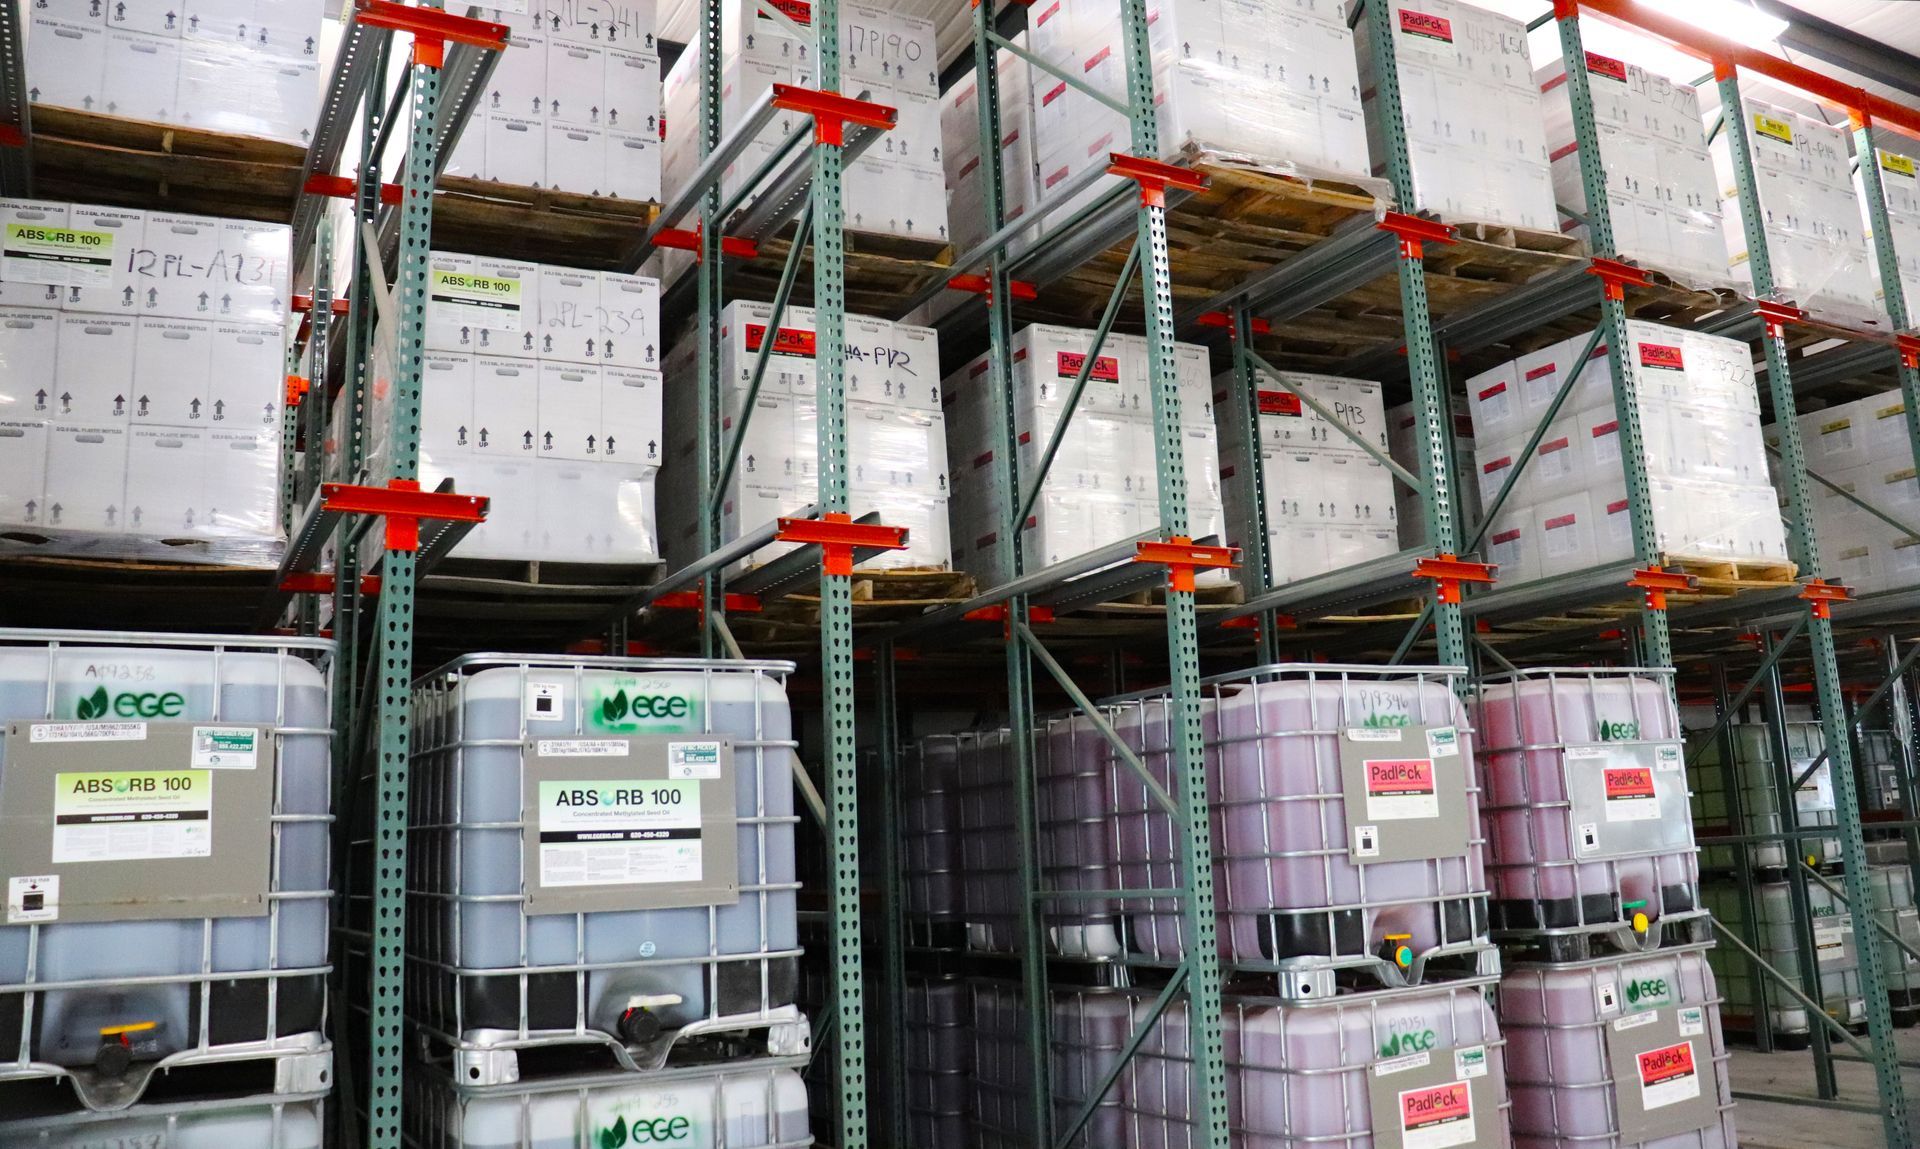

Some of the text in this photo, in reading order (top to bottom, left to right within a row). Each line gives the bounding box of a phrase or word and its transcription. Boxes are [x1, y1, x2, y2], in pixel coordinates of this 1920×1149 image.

[1401, 12, 1444, 32] Padlock
[16, 229, 101, 245] ABSORB 100
[442, 276, 511, 292] ABSORB 100
[1641, 345, 1677, 361] Padlock
[1371, 764, 1422, 781] Padlock
[1607, 771, 1645, 787] Padlock
[73, 777, 192, 795] ABSORB 100
[556, 788, 682, 806] ABSORB 100
[614, 810, 645, 818] Methylated
[1643, 1050, 1685, 1072] Padlock
[1407, 1089, 1458, 1113] Padlock
